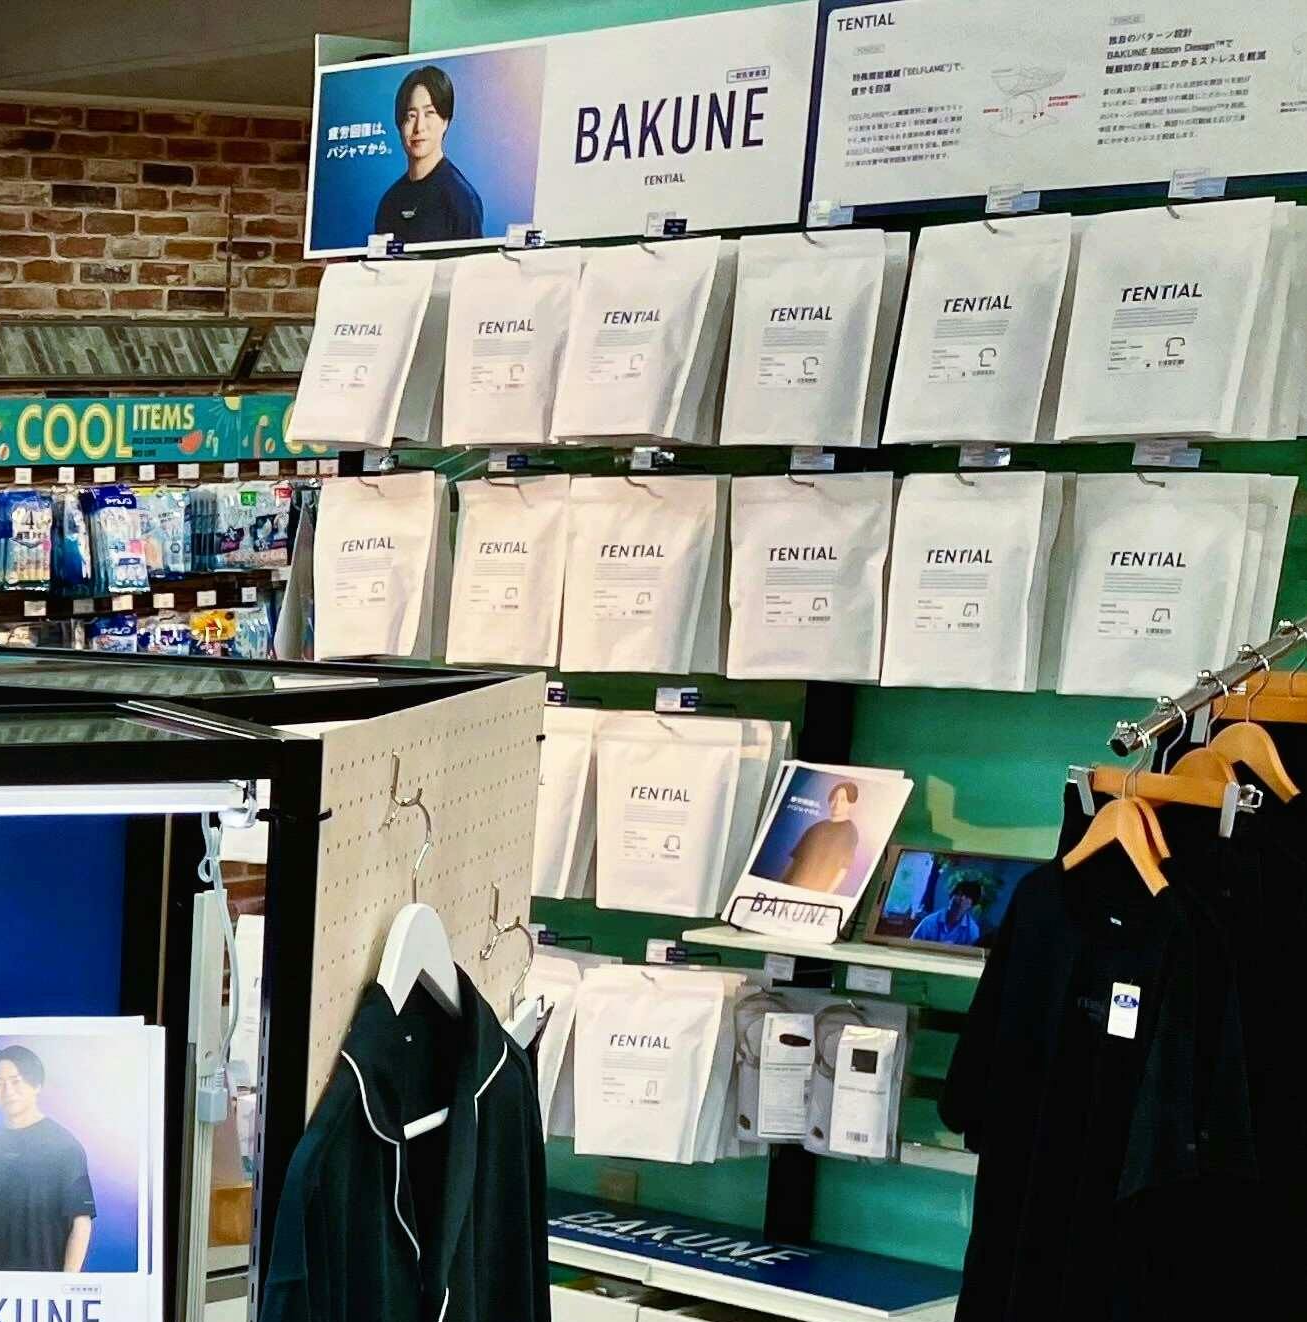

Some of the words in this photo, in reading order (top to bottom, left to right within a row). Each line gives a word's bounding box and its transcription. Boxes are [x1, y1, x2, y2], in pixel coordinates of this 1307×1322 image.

[837, 13, 896, 32] TENTIAL
[574, 87, 769, 165] BAKUNE
[326, 139, 393, 160] パジャマから。
[643, 172, 686, 186] TENTIAL
[1120, 281, 1203, 303] TENTIAL
[942, 295, 1013, 313] TENTIAL
[602, 308, 661, 325] TENTIAL
[768, 305, 833, 322] TENTIAL
[333, 323, 384, 337] TENTIAL
[477, 318, 535, 335] TENTIAL
[17, 403, 133, 461] COOL
[133, 403, 195, 431] ITEMS
[340, 537, 396, 553] TENTIAL
[479, 541, 529, 554] TENTIAL
[600, 544, 665, 558] TENTIAL
[768, 545, 838, 562] TENTIAL
[926, 548, 993, 564] TENTIAL
[1110, 551, 1186, 568] TENTIAL
[630, 786, 691, 803] TENTIAL
[608, 1032, 672, 1050] TENTIAL
[558, 1210, 810, 1265] BAKUNE
